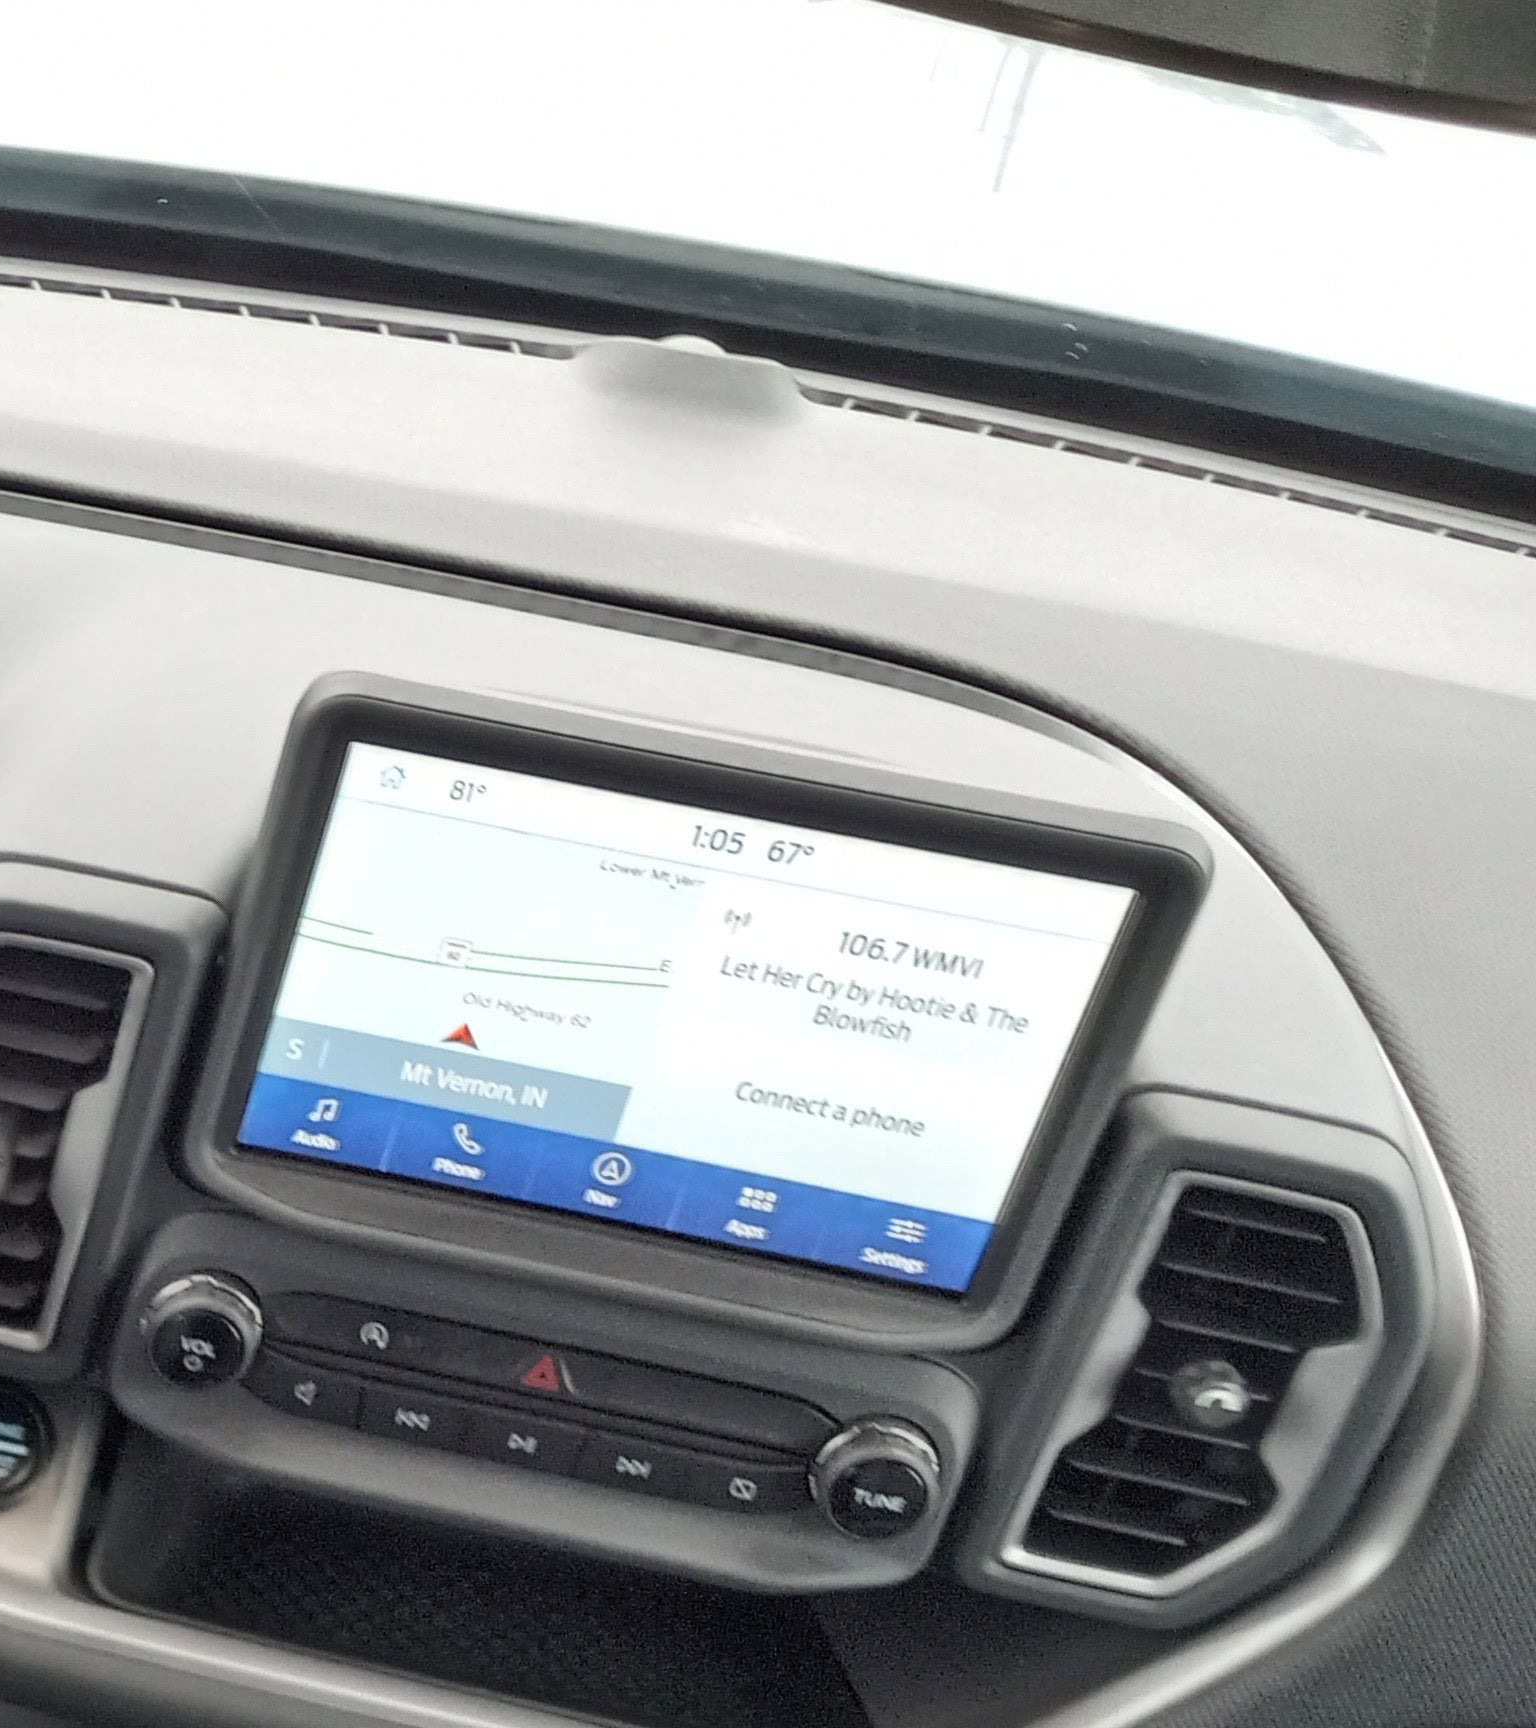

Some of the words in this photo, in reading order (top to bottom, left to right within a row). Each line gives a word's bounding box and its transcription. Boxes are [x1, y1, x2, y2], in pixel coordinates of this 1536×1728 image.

[690, 825, 746, 855] 1:05
[838, 931, 909, 964] 106.7
[912, 946, 984, 980] WMVI
[720, 955, 755, 981] Let
[762, 963, 804, 991] Her
[806, 972, 842, 1001] Cry
[847, 979, 872, 1007] by
[878, 986, 956, 1020] Hootie
[959, 1001, 978, 1024] &
[987, 1006, 1029, 1034] The
[812, 1004, 912, 1043] Blowfish
[286, 1037, 305, 1061] S
[400, 1059, 432, 1087] Mt
[435, 1066, 517, 1107] Vernon,
[520, 1083, 549, 1109] IN
[736, 1080, 830, 1121] Connect
[832, 1105, 847, 1122] a
[850, 1102, 926, 1139] phone
[290, 1128, 341, 1152] Audio
[432, 1156, 485, 1182] Phone
[582, 1186, 621, 1209] Nav
[724, 1217, 769, 1243] Apps
[858, 1245, 929, 1275] Settings
[854, 1486, 908, 1514] TUNE
